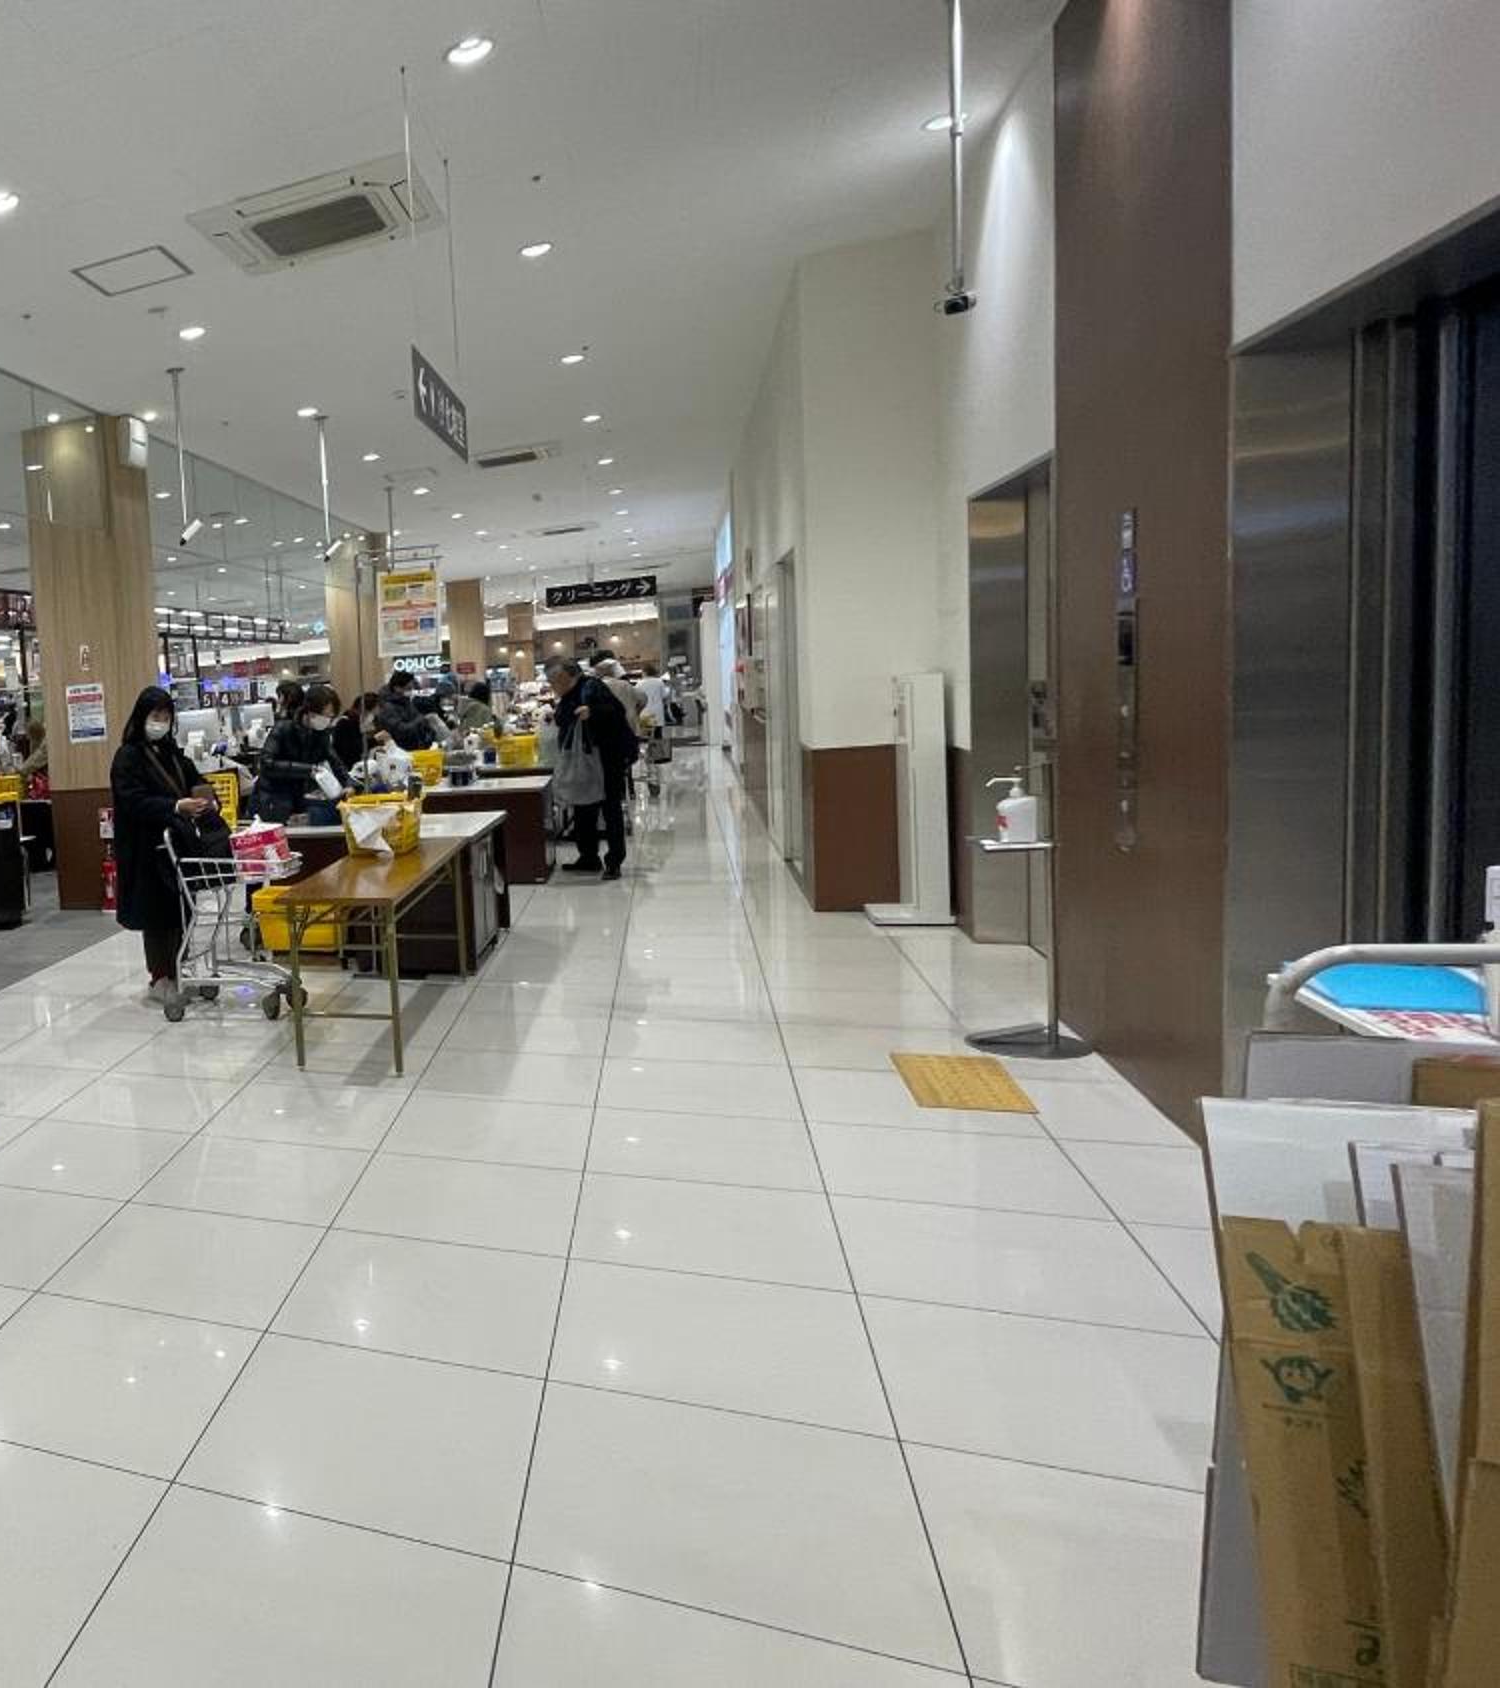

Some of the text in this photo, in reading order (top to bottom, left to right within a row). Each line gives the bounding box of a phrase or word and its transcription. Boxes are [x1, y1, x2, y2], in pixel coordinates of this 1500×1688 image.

[551, 581, 631, 603] クリーニング
